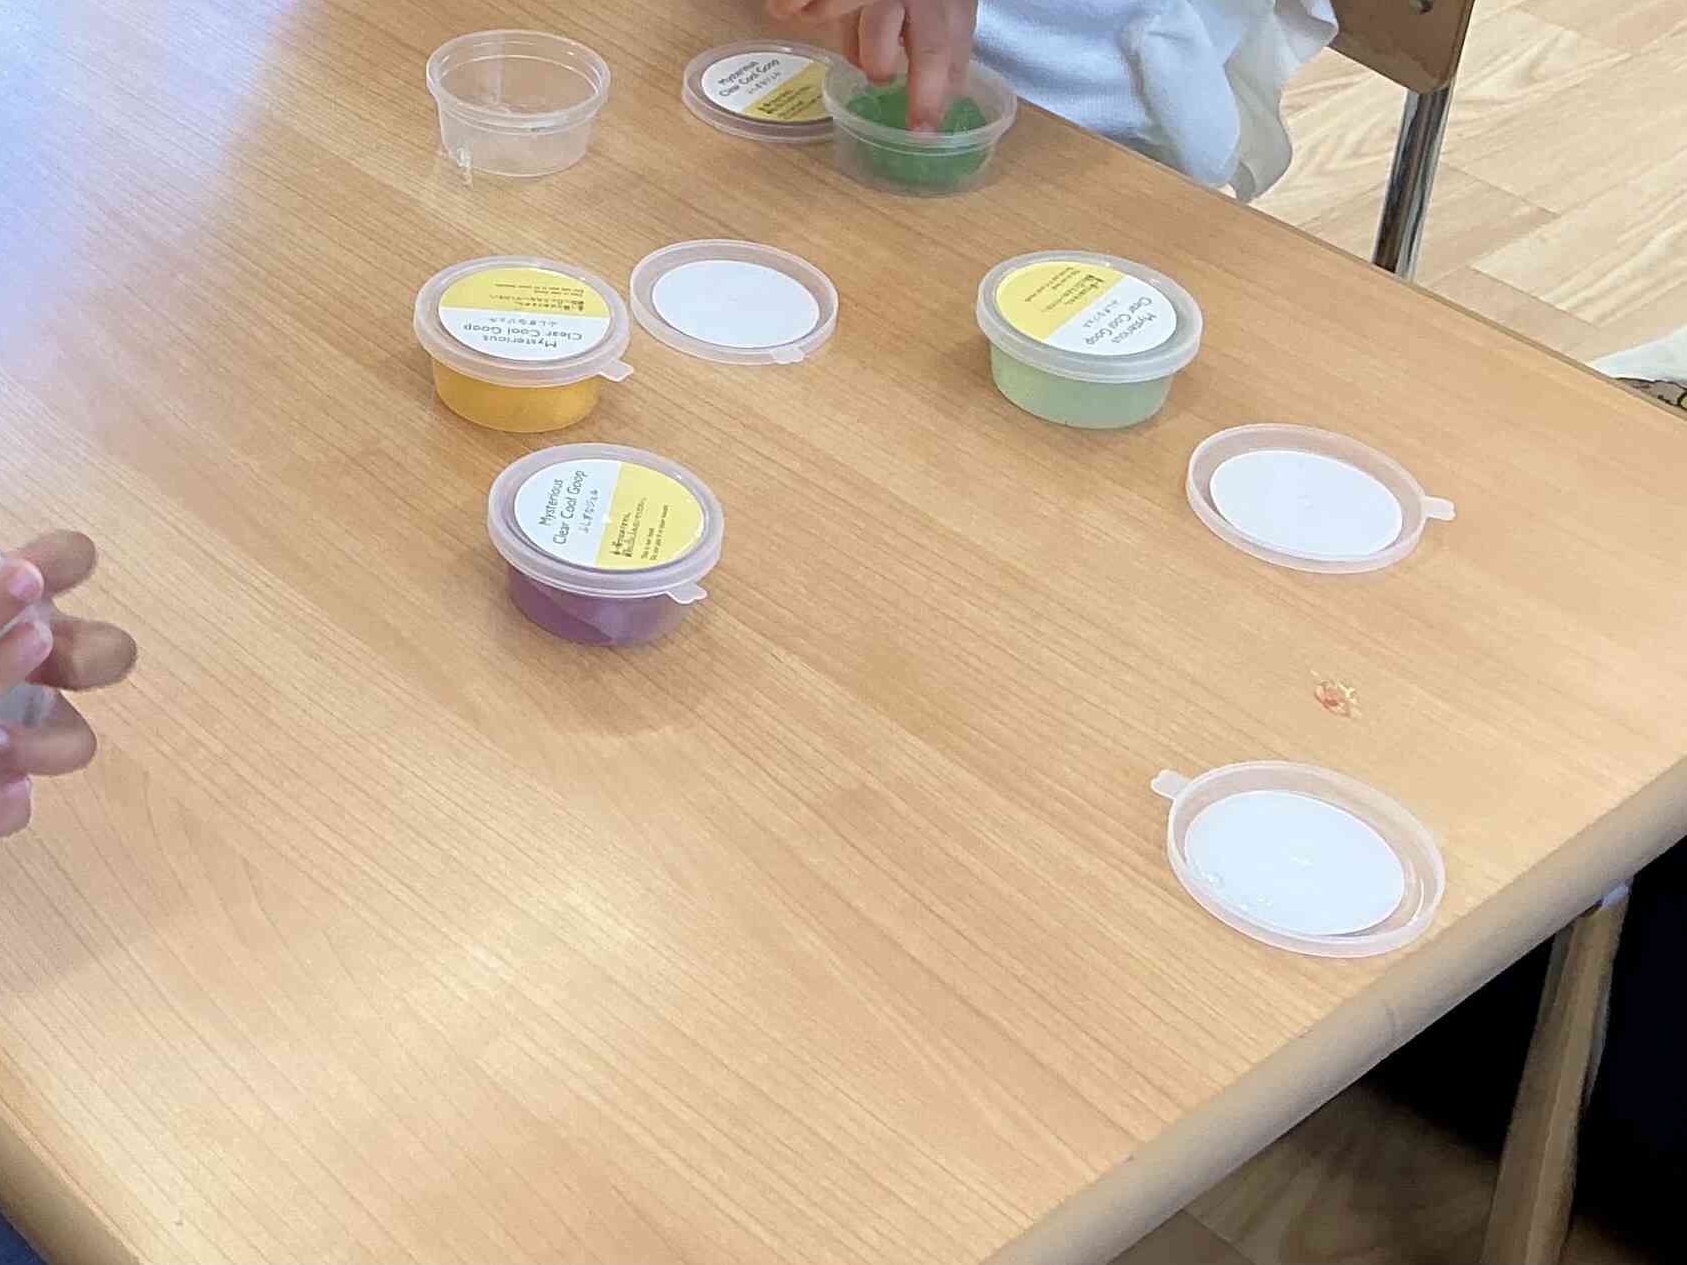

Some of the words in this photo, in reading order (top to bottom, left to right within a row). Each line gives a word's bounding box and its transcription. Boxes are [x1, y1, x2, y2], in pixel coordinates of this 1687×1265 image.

[463, 323, 503, 335] Goop
[507, 327, 541, 338] Cool
[547, 330, 583, 341] Clear
[482, 335, 558, 348] Mysterious
[567, 470, 589, 495] Goop
[538, 478, 564, 527] Mysterious
[560, 496, 578, 520] Cool
[553, 521, 570, 545] Clear
